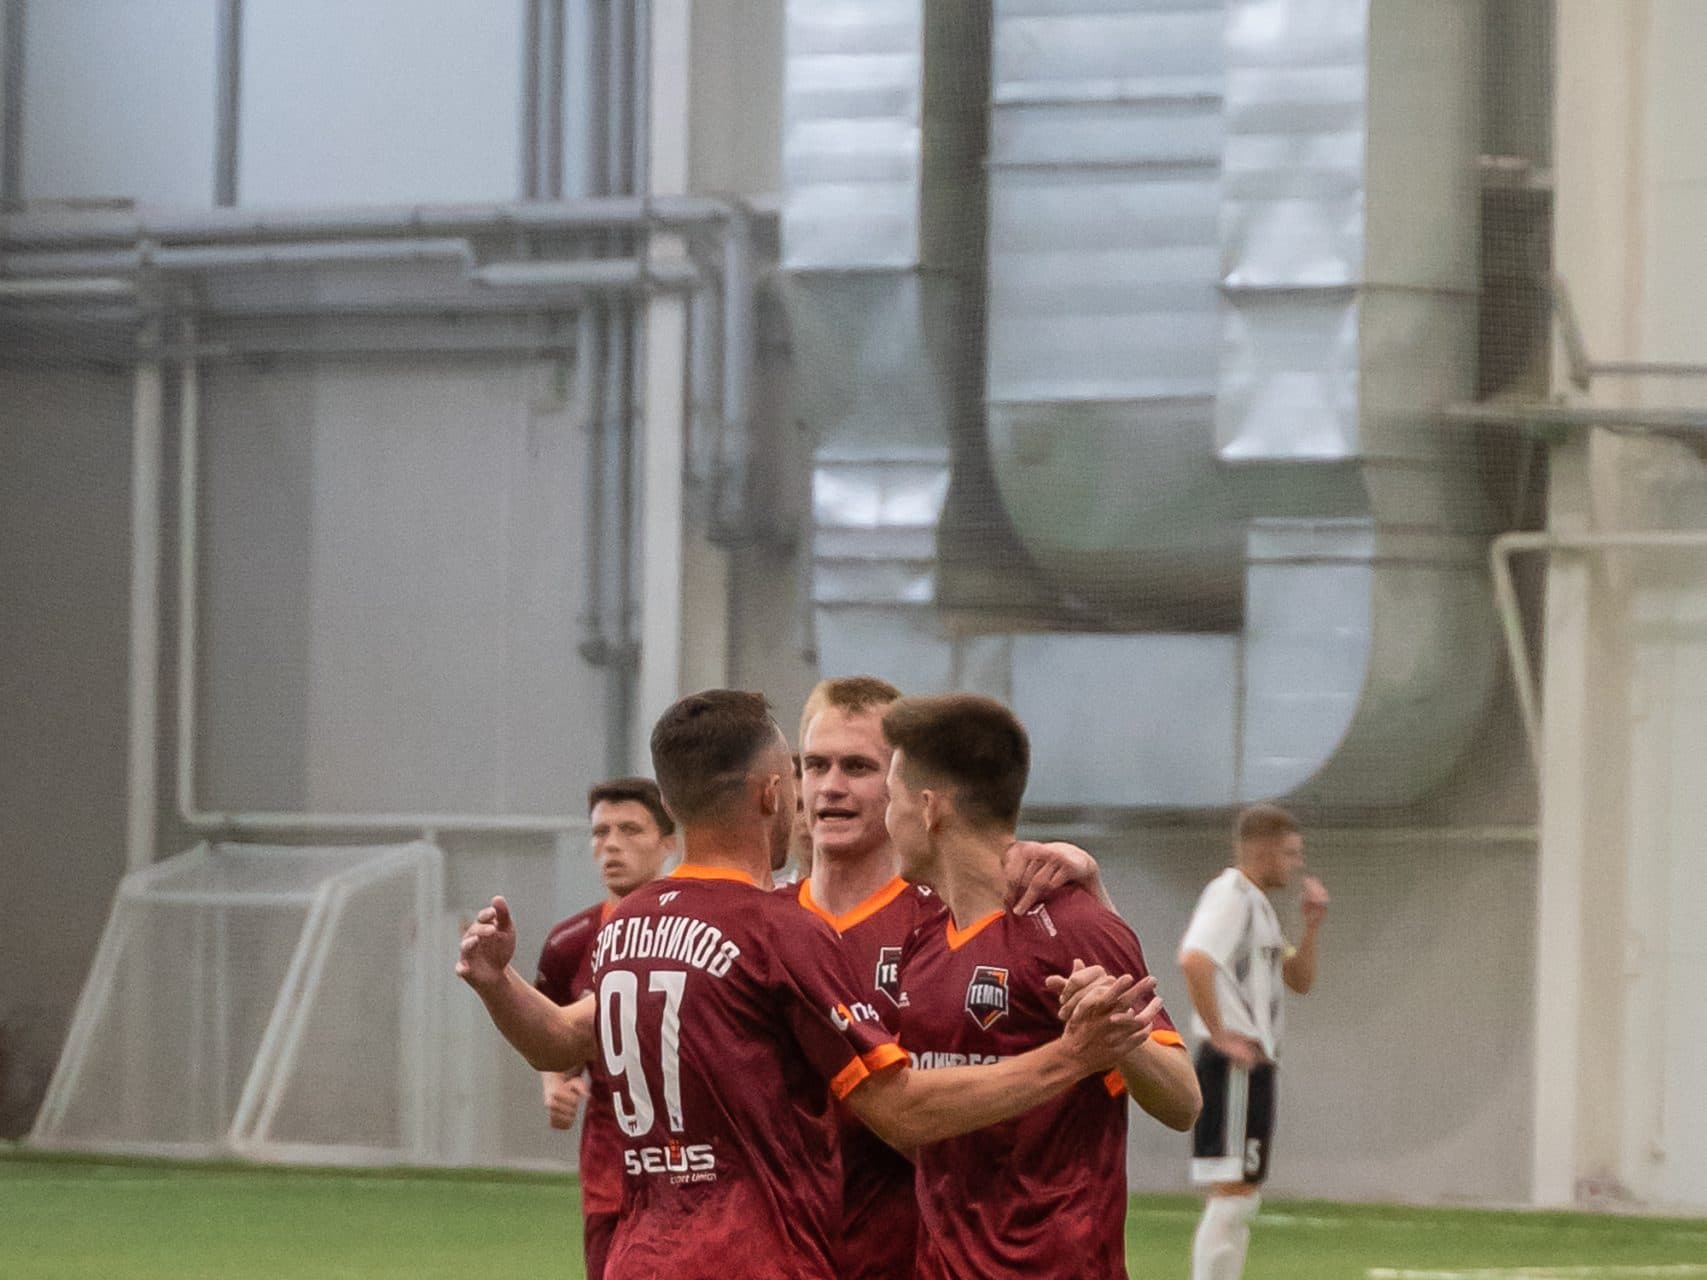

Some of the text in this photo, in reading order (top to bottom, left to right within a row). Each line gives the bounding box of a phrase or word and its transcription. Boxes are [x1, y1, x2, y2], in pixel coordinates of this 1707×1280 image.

[970, 984, 1003, 1008] ТЕМП
[600, 970, 687, 1136] 97
[624, 1144, 715, 1176] SEUS
